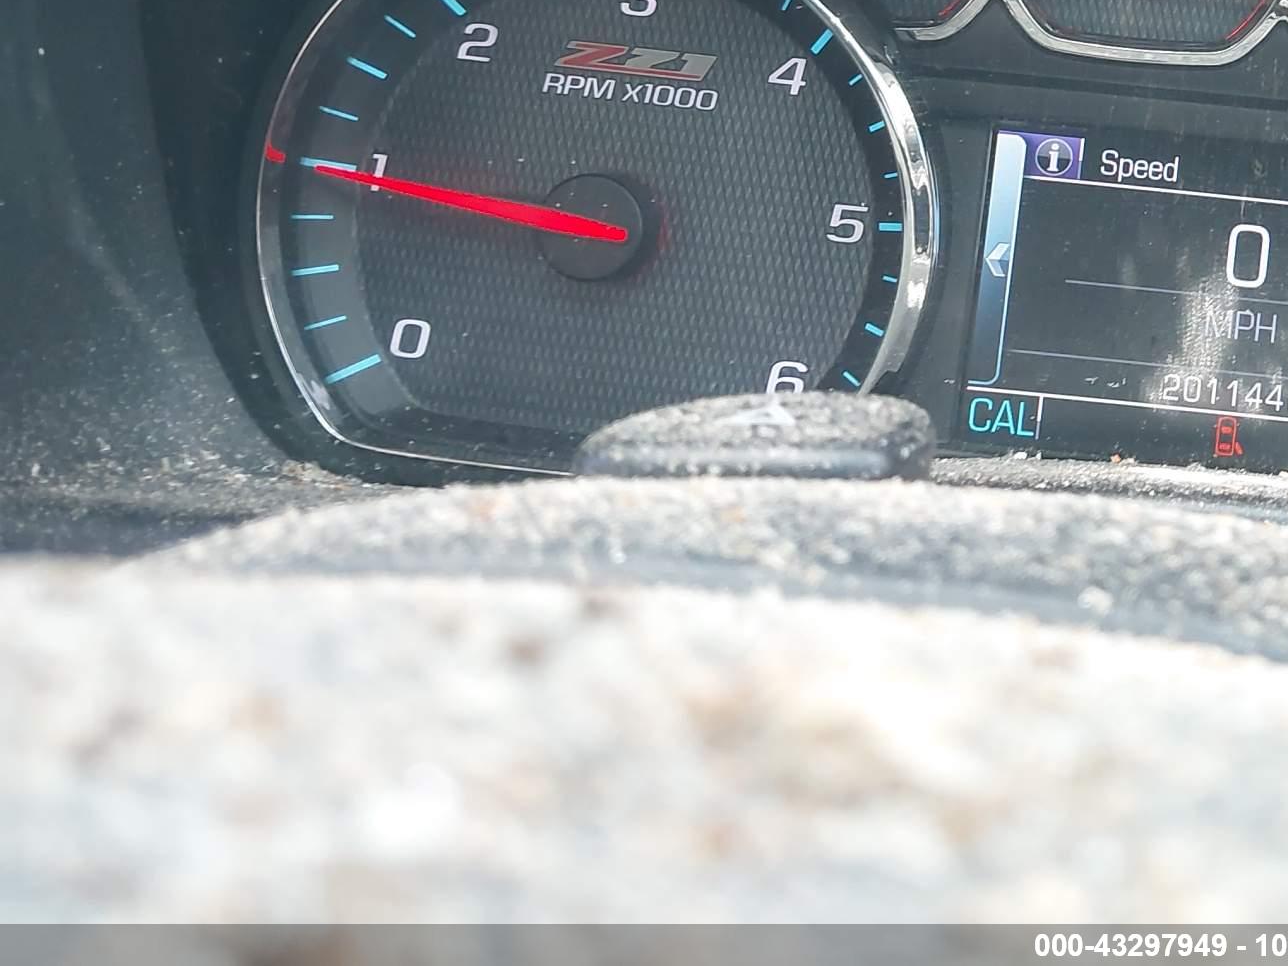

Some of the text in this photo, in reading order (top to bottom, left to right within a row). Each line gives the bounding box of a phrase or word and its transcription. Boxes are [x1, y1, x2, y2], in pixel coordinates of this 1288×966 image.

[456, 22, 499, 63] 2
[541, 71, 615, 101] RPM
[767, 56, 807, 96] 4
[368, 153, 391, 192] 1
[1099, 148, 1180, 184] Speed
[825, 203, 870, 244] 5
[1225, 223, 1271, 289] 0
[388, 318, 432, 359] 0
[1207, 310, 1277, 344] MPH
[1163, 373, 1284, 410] 201144
[967, 396, 1034, 438] CAL
